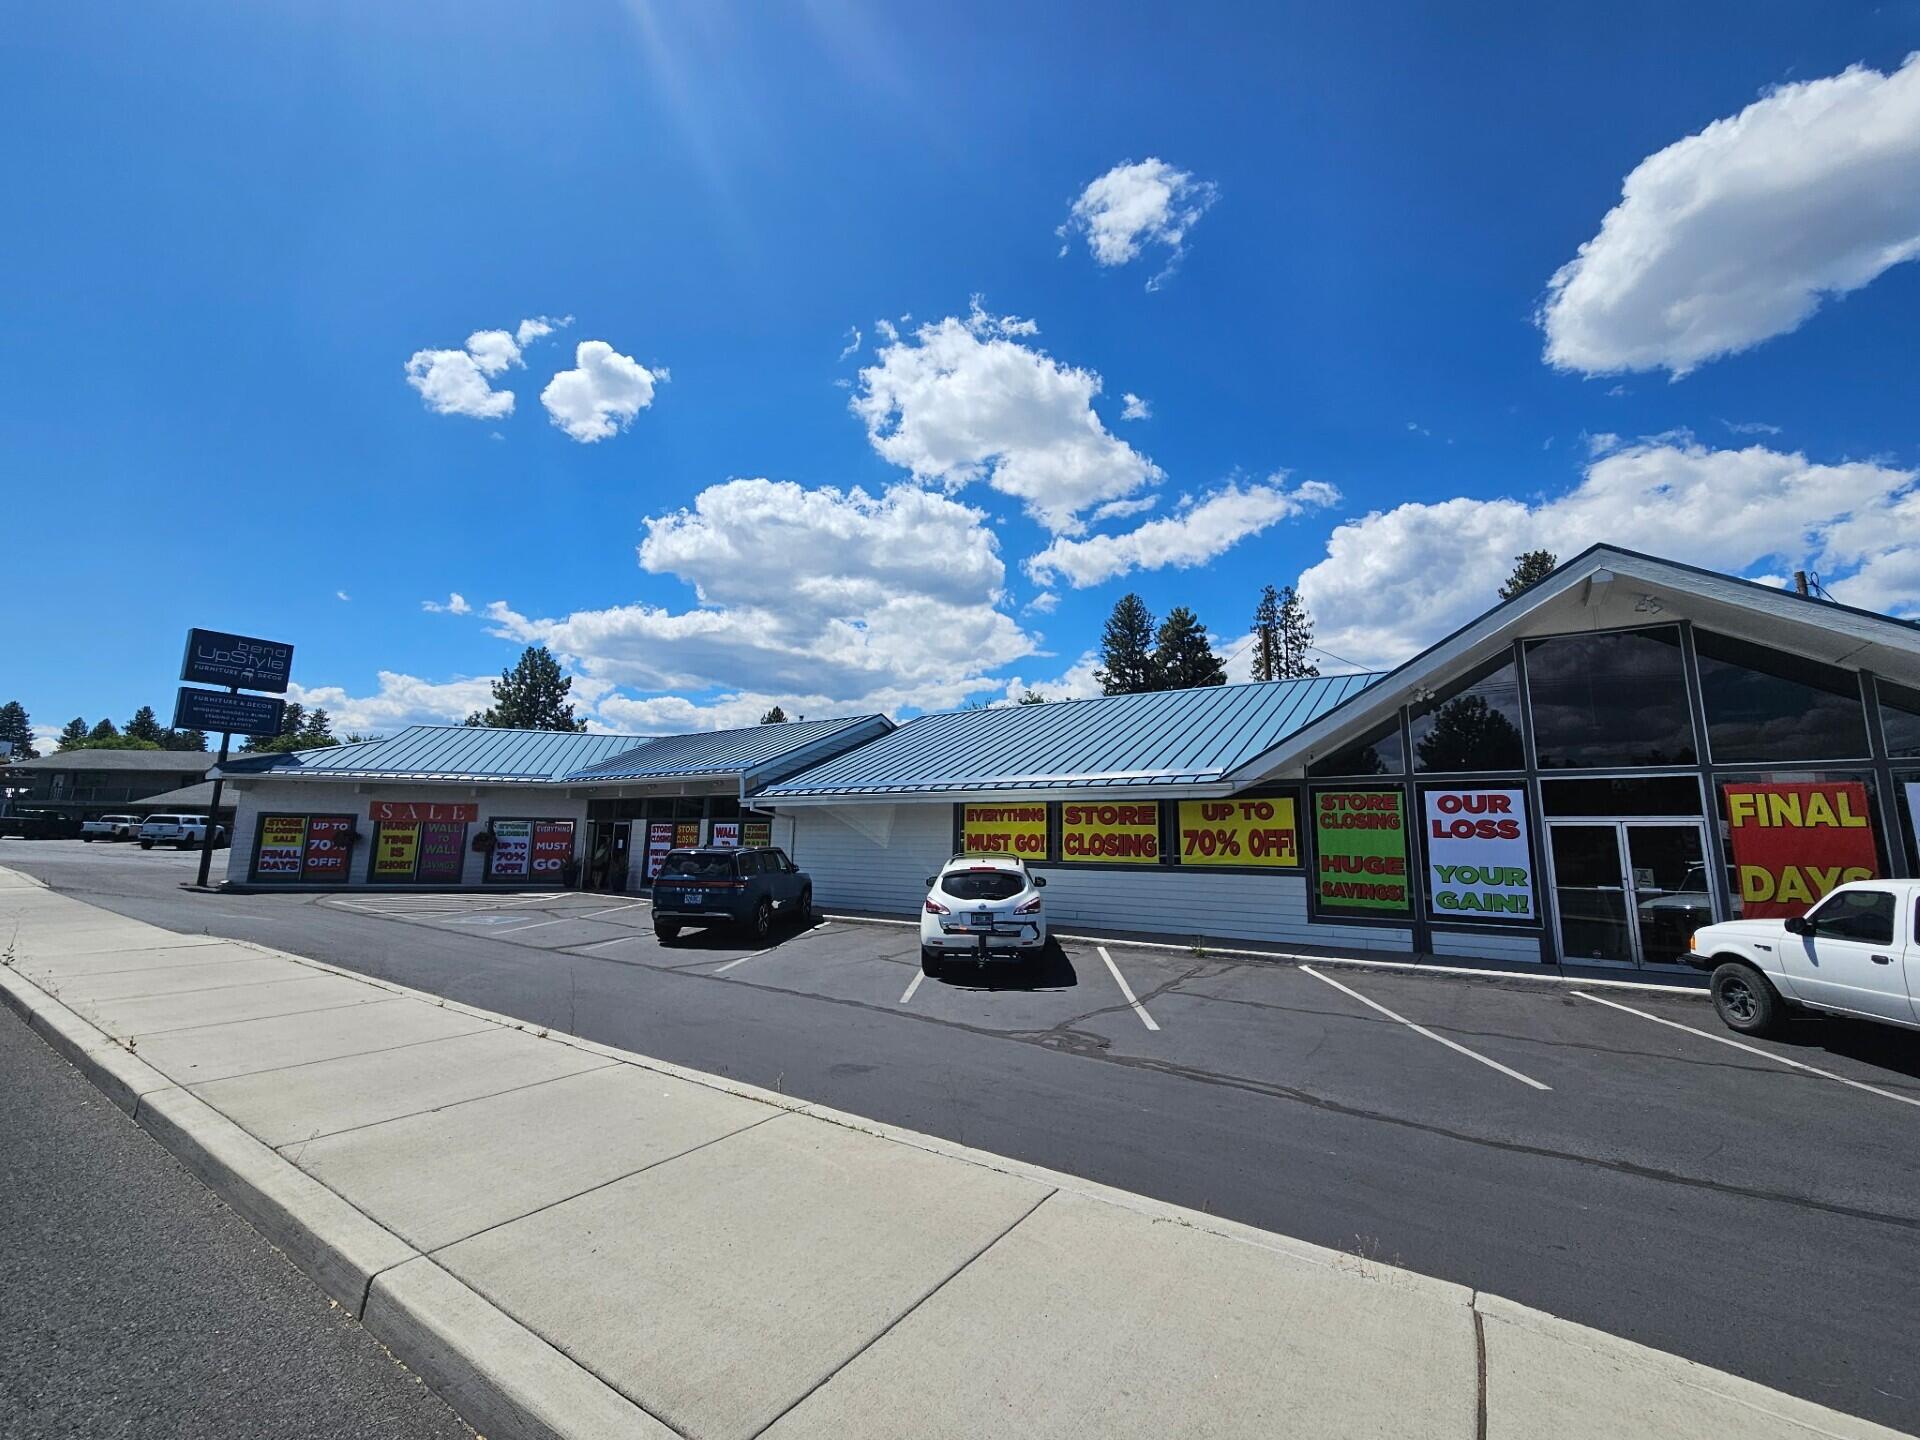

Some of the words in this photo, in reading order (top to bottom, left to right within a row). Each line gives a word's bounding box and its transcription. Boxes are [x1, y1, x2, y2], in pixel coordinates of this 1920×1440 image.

[238, 641, 287, 658] bend
[198, 645, 284, 669] UpStyle
[194, 665, 238, 675] FURNITURE
[257, 673, 283, 681] DECOR
[193, 695, 238, 706] FURNITURE
[247, 701, 272, 709] DECOR
[1320, 793, 1400, 811] STORE
[1437, 794, 1512, 814] OUR
[380, 803, 465, 820] SALE
[966, 807, 1045, 823] EVERYTHING
[1064, 805, 1157, 826] STORE
[1201, 803, 1233, 821] UP
[1239, 802, 1275, 821] TO
[1729, 791, 1868, 828] FINAL
[266, 818, 303, 827] STORE
[312, 822, 329, 830] UP
[332, 823, 348, 831] TO
[429, 823, 460, 833] WALL
[1320, 812, 1400, 830] CLOSING
[536, 825, 570, 833] EVERYTHING
[677, 825, 698, 833] STORE
[716, 826, 738, 838] WALL
[1432, 819, 1521, 840] LOSS
[272, 835, 297, 843] SALE
[383, 835, 413, 845] TIME
[439, 835, 449, 843] TO
[497, 842, 512, 850] UP
[536, 842, 568, 850] MUST
[966, 834, 1011, 851] MUST
[1015, 833, 1045, 853] GO!
[1064, 832, 1158, 858] CLOSING
[1183, 828, 1240, 857] 70%
[1248, 828, 1295, 858] OFF!
[261, 849, 300, 859] FINAL
[390, 847, 404, 857] IS
[424, 843, 456, 855] WALL
[496, 851, 526, 861] 70%
[259, 860, 299, 870] DAYS
[308, 857, 341, 867] OFF!
[378, 860, 413, 870] SHORT
[495, 863, 523, 873] OFF!
[1321, 855, 1405, 876] HUGE
[1433, 864, 1528, 887] YOUR
[1322, 880, 1406, 901] SAVINGS!
[1436, 891, 1530, 914] GAIN!
